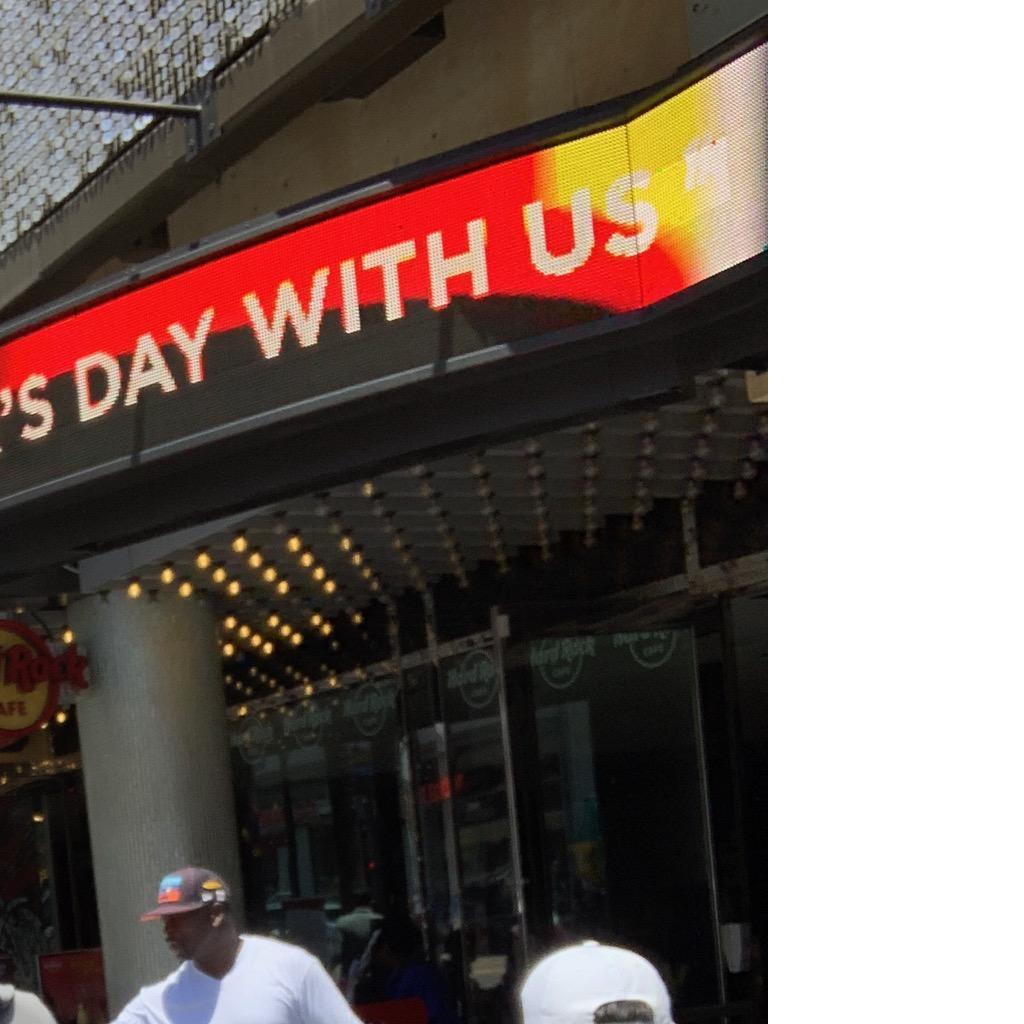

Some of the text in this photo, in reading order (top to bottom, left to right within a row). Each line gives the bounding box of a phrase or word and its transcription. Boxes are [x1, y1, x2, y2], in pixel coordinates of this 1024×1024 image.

[75, 307, 215, 423] DAY
[242, 218, 489, 359] WITH
[523, 169, 658, 277] US
[4, 644, 90, 693] Rock
